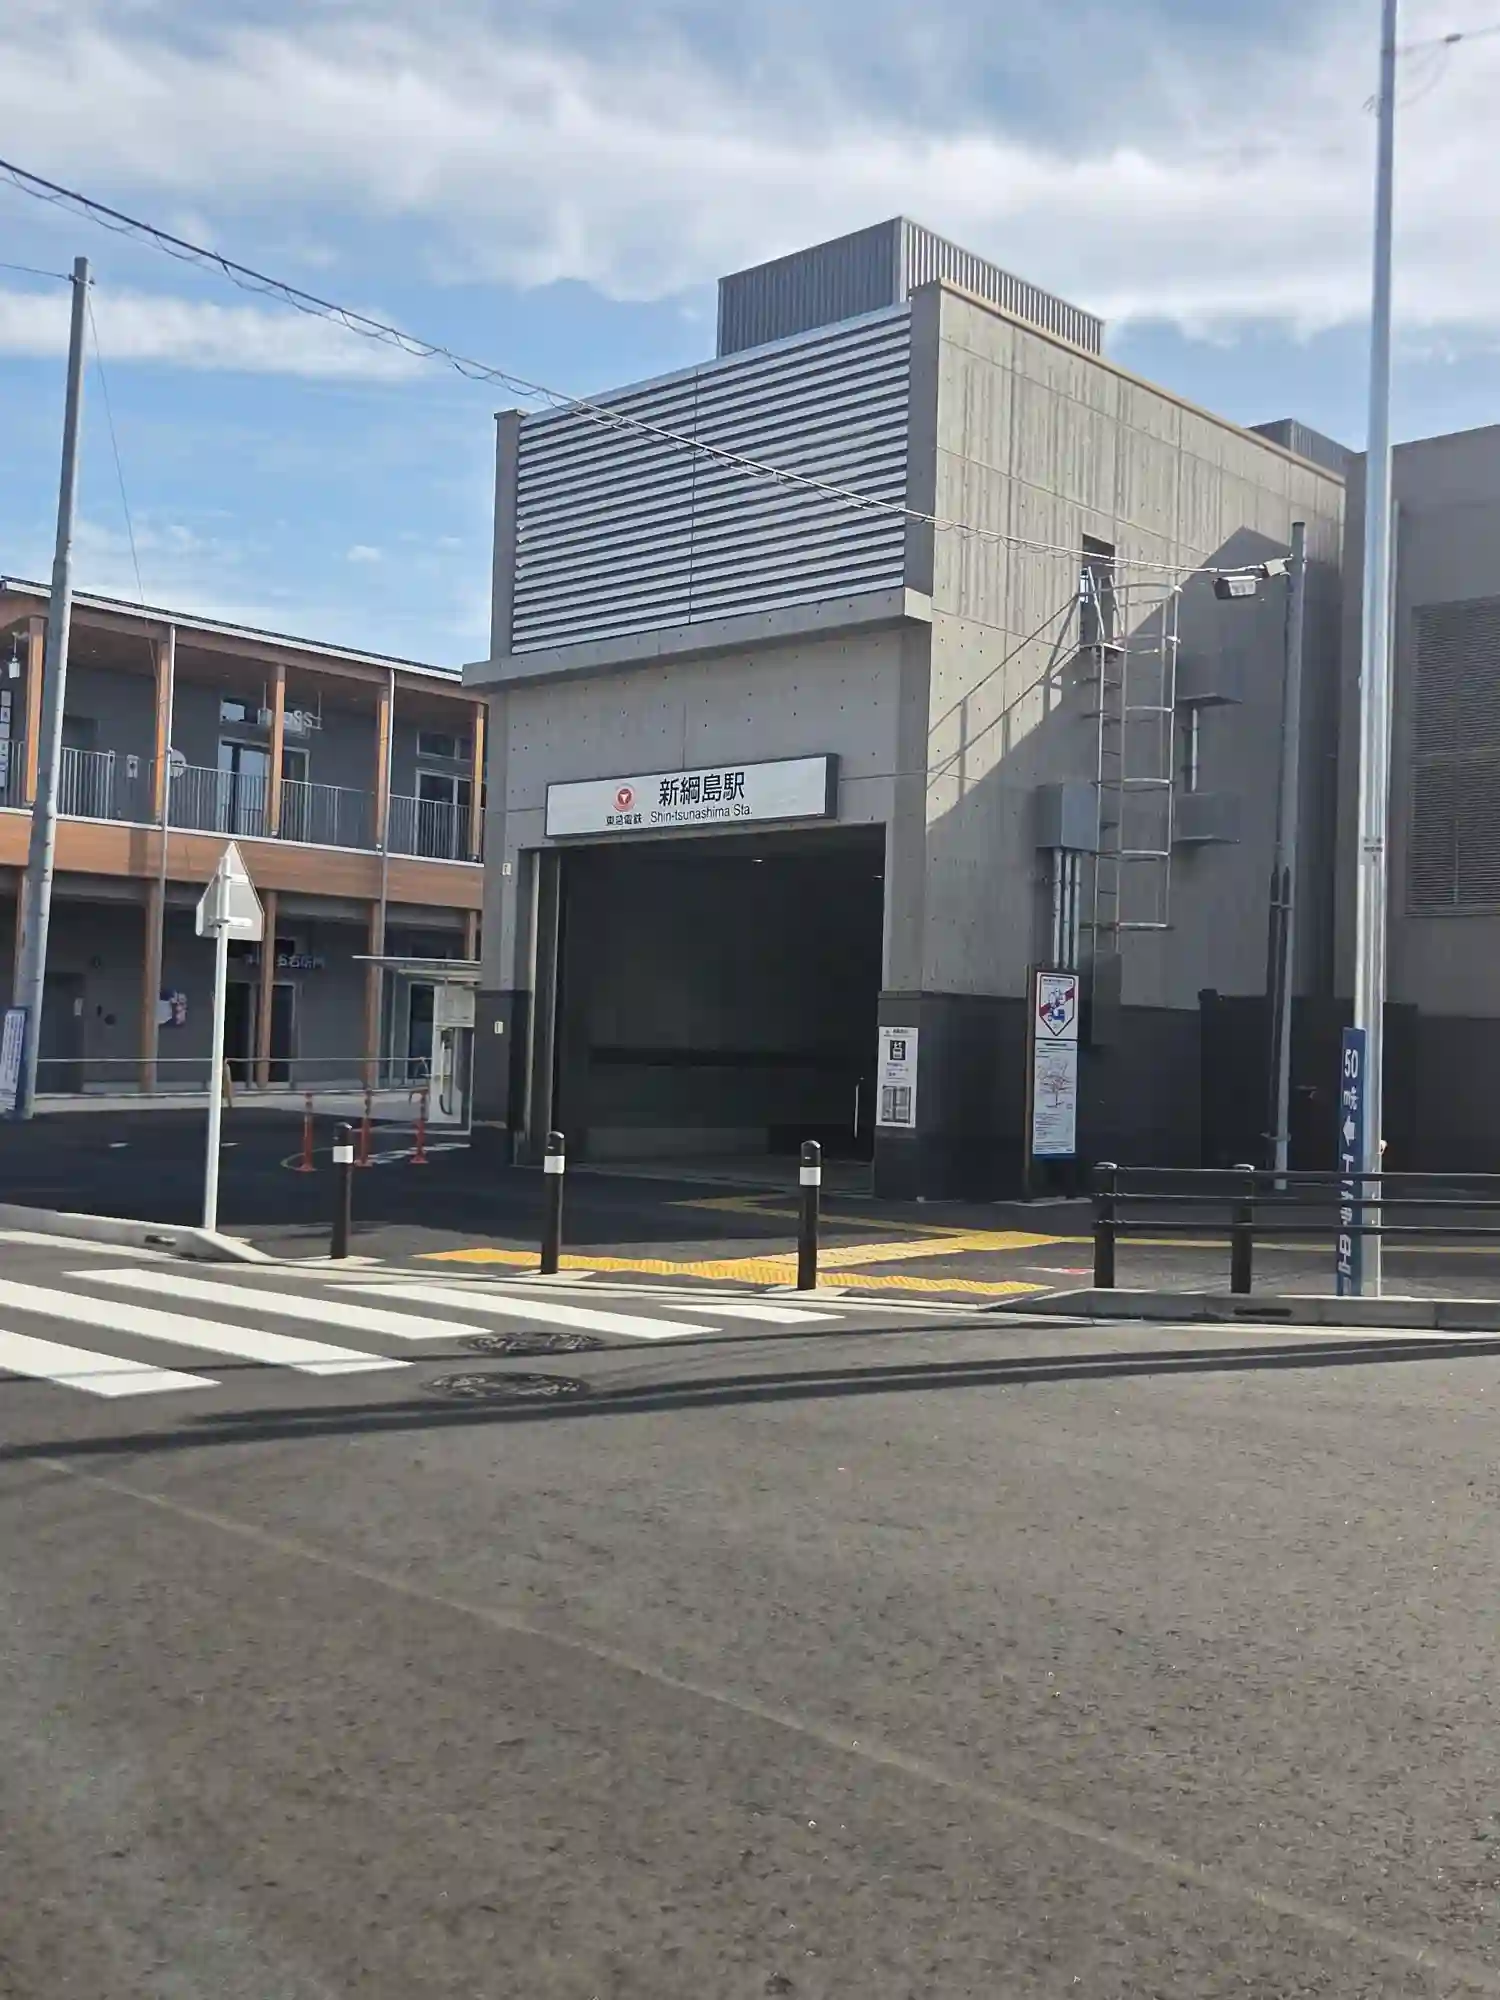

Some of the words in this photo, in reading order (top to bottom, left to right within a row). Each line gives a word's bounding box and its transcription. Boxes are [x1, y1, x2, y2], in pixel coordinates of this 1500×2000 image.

[659, 771, 745, 806] 新綱島駅
[650, 807, 730, 823] Shin-tsunashima
[733, 804, 752, 816] Sta.
[1344, 1048, 1359, 1078] 50
